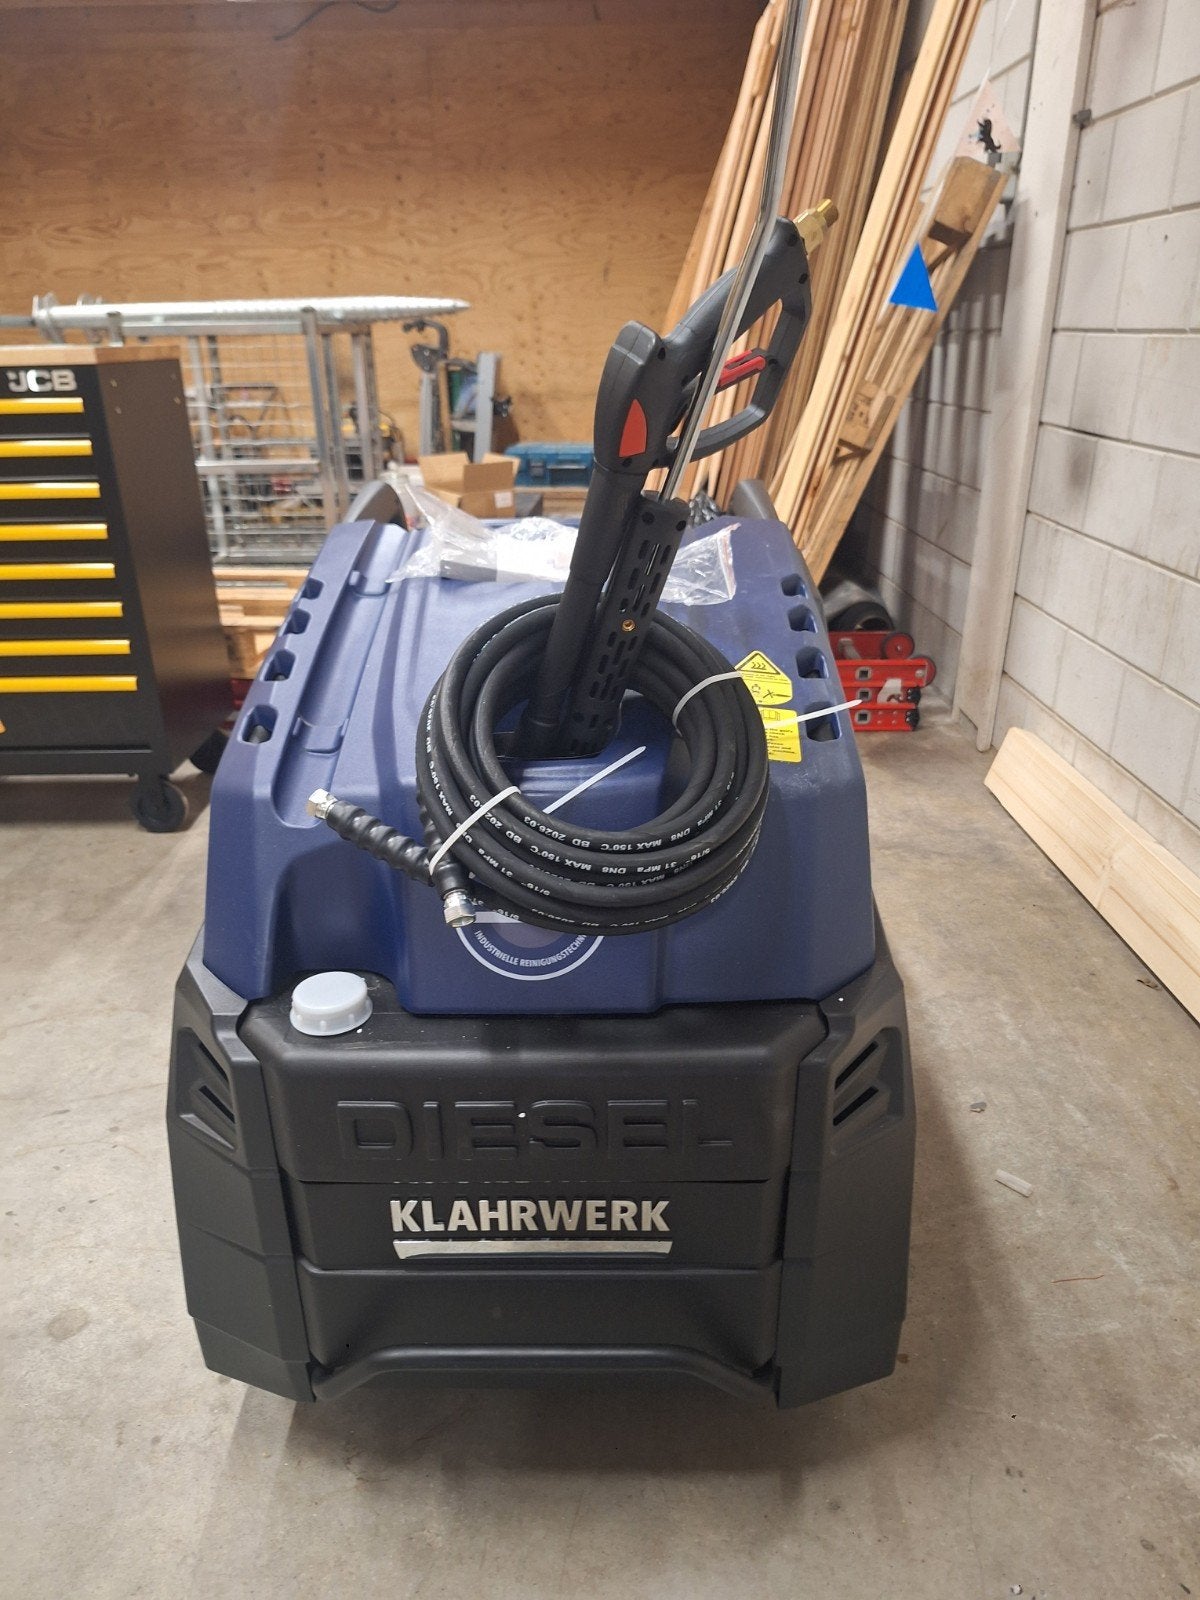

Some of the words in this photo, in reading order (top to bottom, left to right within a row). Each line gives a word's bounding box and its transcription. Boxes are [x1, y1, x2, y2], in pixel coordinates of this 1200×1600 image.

[6, 369, 77, 392] JCB
[439, 791, 454, 816] MAX
[505, 830, 522, 844] BD
[572, 838, 590, 848] BD
[600, 843, 632, 851] 150°C
[636, 839, 662, 850] MAX
[530, 845, 560, 862] 150°C
[565, 859, 592, 871] MAX
[602, 866, 627, 874] DN8
[637, 864, 661, 873] MPa
[665, 861, 677, 869] 31
[474, 930, 518, 966] INDUSTRIELLE
[337, 1100, 734, 1160] DIESEL
[390, 1200, 671, 1232] KLAHRWERK
